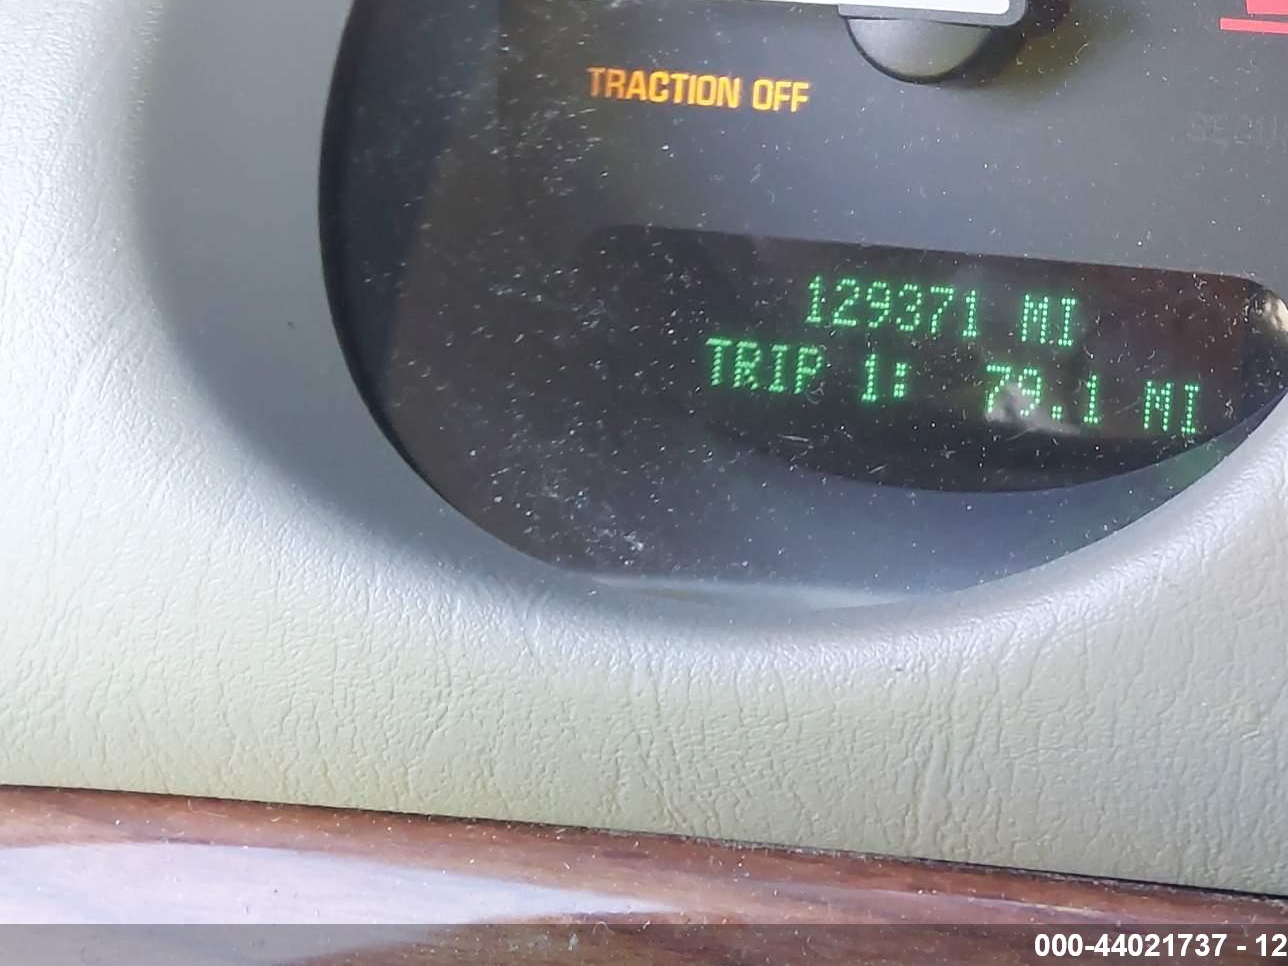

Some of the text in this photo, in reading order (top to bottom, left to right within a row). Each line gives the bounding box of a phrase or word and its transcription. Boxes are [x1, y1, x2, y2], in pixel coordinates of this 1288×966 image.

[587, 66, 811, 112] TRACTION OFF
[806, 275, 1078, 348] 129371 MI
[704, 335, 1201, 436] TRIP 1: 79.1 MI
